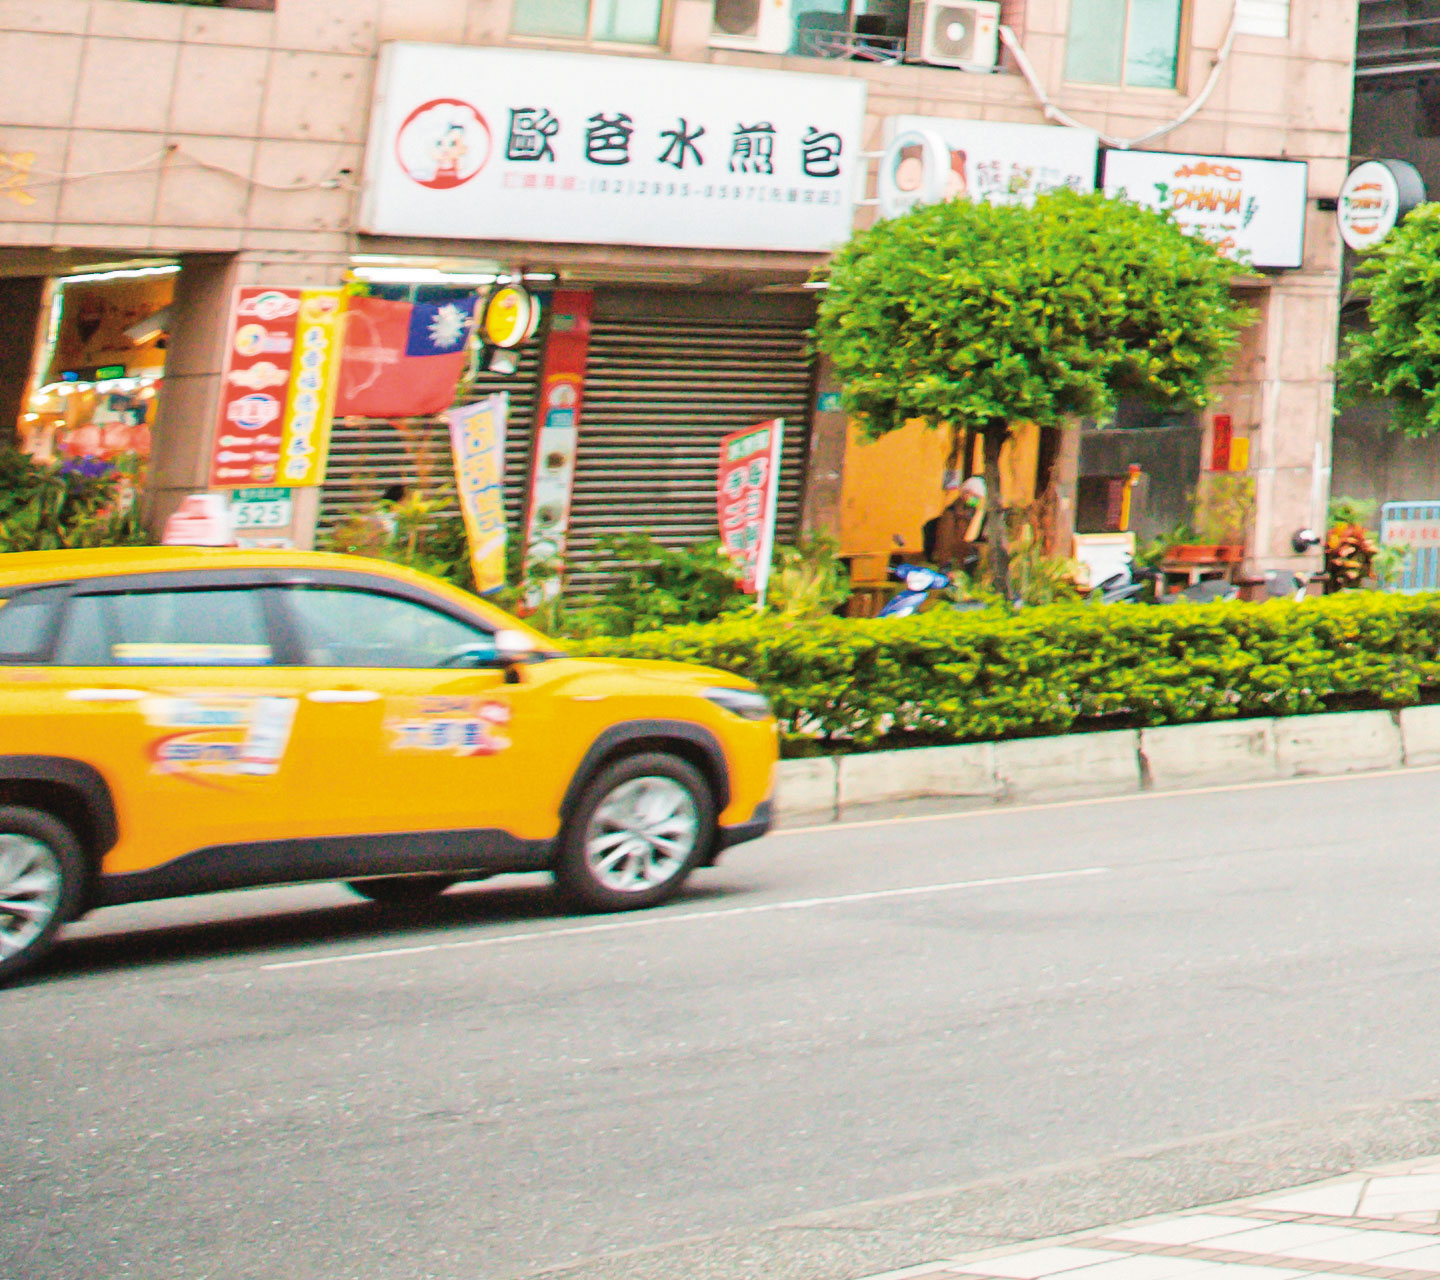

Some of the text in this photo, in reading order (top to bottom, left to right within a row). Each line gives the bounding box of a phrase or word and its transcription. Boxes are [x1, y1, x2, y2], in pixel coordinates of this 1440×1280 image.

[505, 107, 843, 178] 歐爸水煎包
[237, 505, 282, 524] 525
